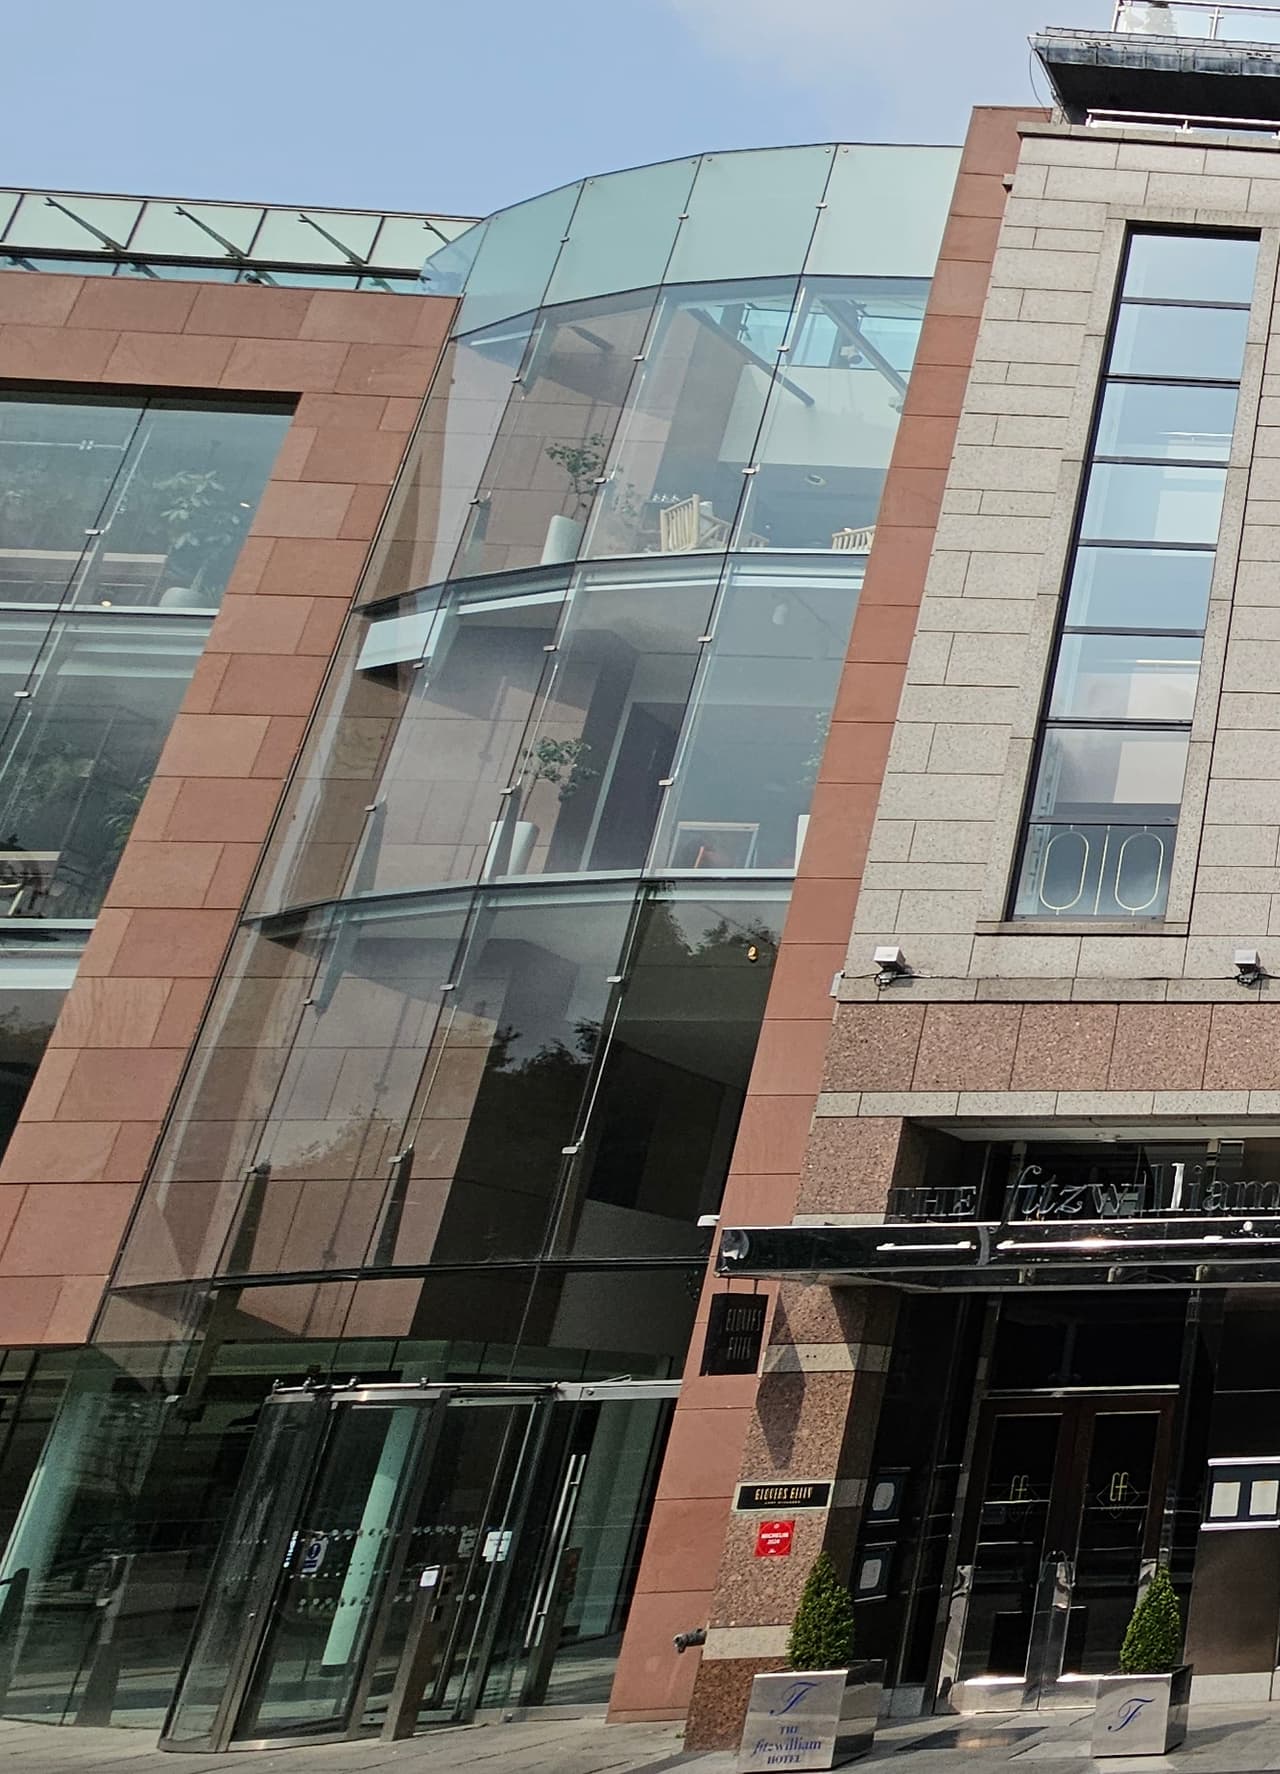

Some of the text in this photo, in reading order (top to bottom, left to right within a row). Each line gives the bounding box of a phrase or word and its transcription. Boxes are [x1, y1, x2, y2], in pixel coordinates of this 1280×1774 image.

[886, 1186, 977, 1217] THE
[780, 1726, 798, 1735] THE
[750, 1738, 822, 1758] fitzwilliam
[767, 1755, 801, 1765] HOTEL
